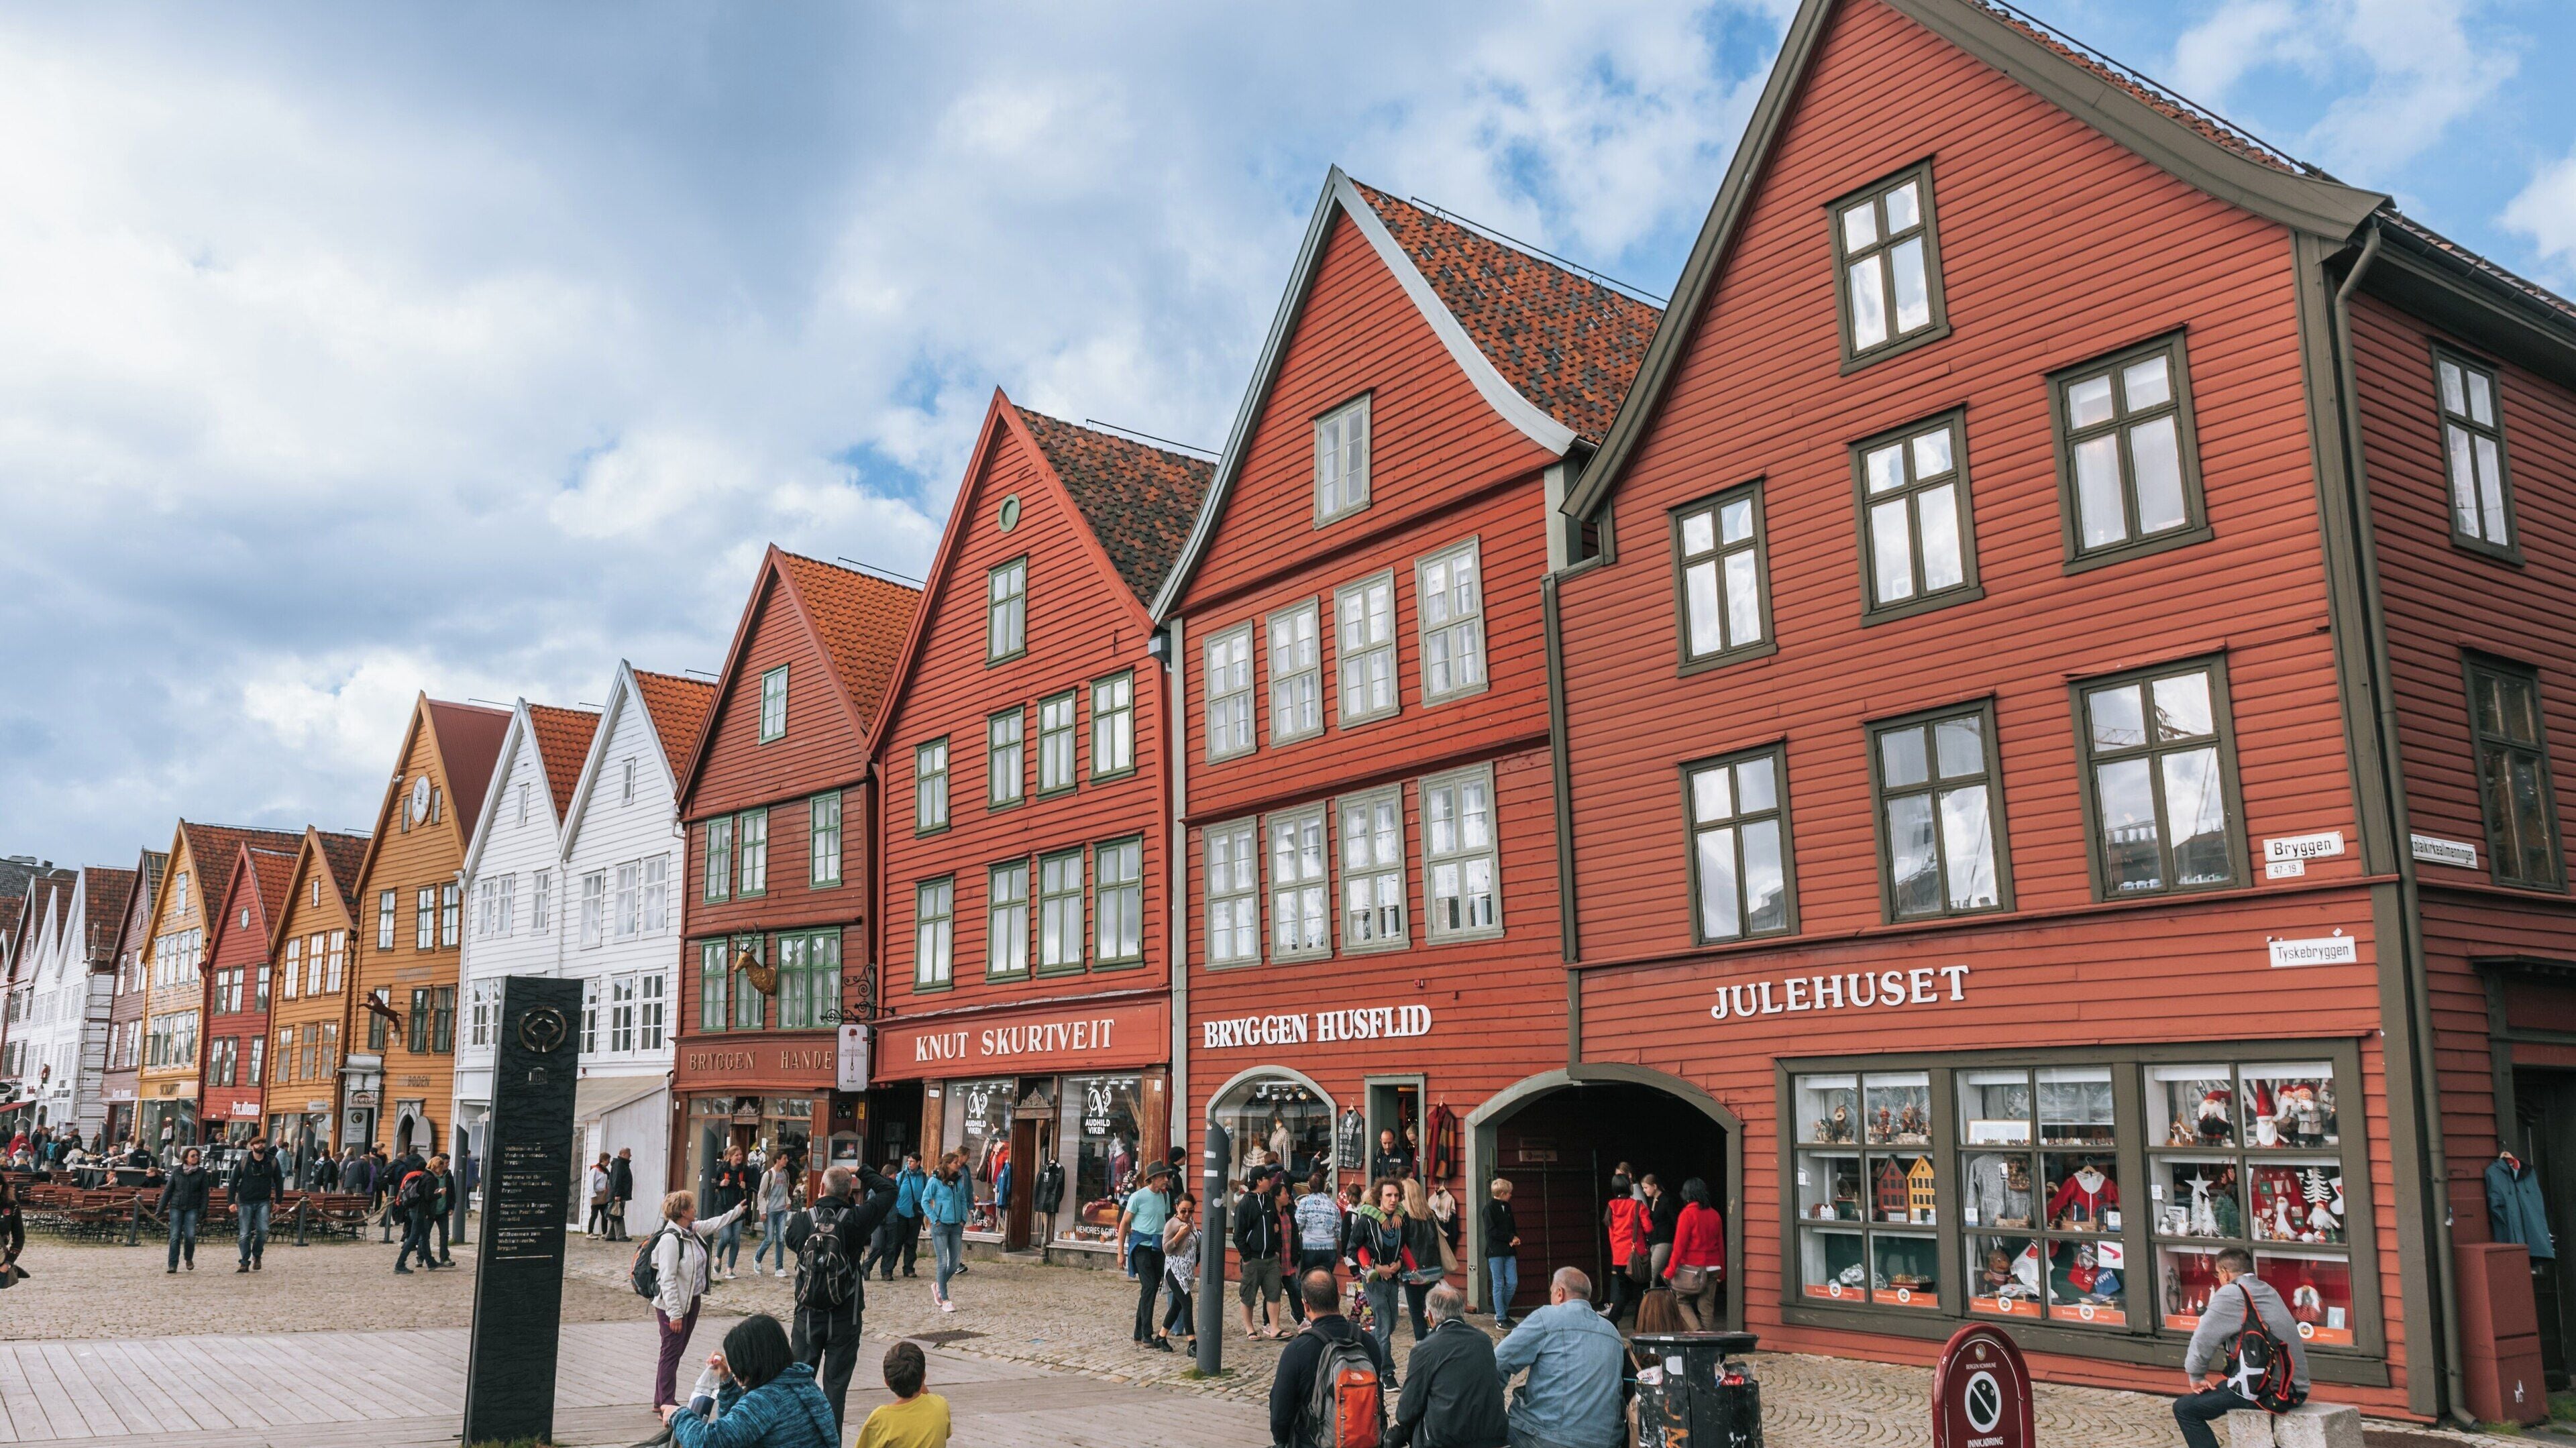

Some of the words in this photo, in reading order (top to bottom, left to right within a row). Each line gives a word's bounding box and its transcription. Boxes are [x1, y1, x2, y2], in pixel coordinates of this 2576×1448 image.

[2273, 840, 2332, 858] Bryggen
[2273, 864, 2297, 875] 47-19
[2275, 945, 2349, 962] Tyskebryggen
[1710, 964, 1970, 1019] JULEHUSET
[1203, 1013, 1309, 1049] BRYGGEN
[1316, 1004, 1432, 1042] HUSFLID
[915, 1032, 969, 1062] KNUT
[980, 1019, 1116, 1056] SKURTVEIT
[689, 1051, 755, 1071] BRYGGEN
[780, 1050, 835, 1070] HANDE
[965, 1119, 987, 1128] AUDHILD
[1085, 1118, 1111, 1127] AUDHILD
[967, 1126, 983, 1135] VIKEN
[1087, 1126, 1106, 1135] VIKEN
[1076, 1225, 1100, 1235] MEMORIES
[1105, 1228, 1118, 1237] GIFTS
[1980, 1361, 1997, 1370] KOMMUNE
[1967, 1436, 2004, 1448] INNKJØRING
